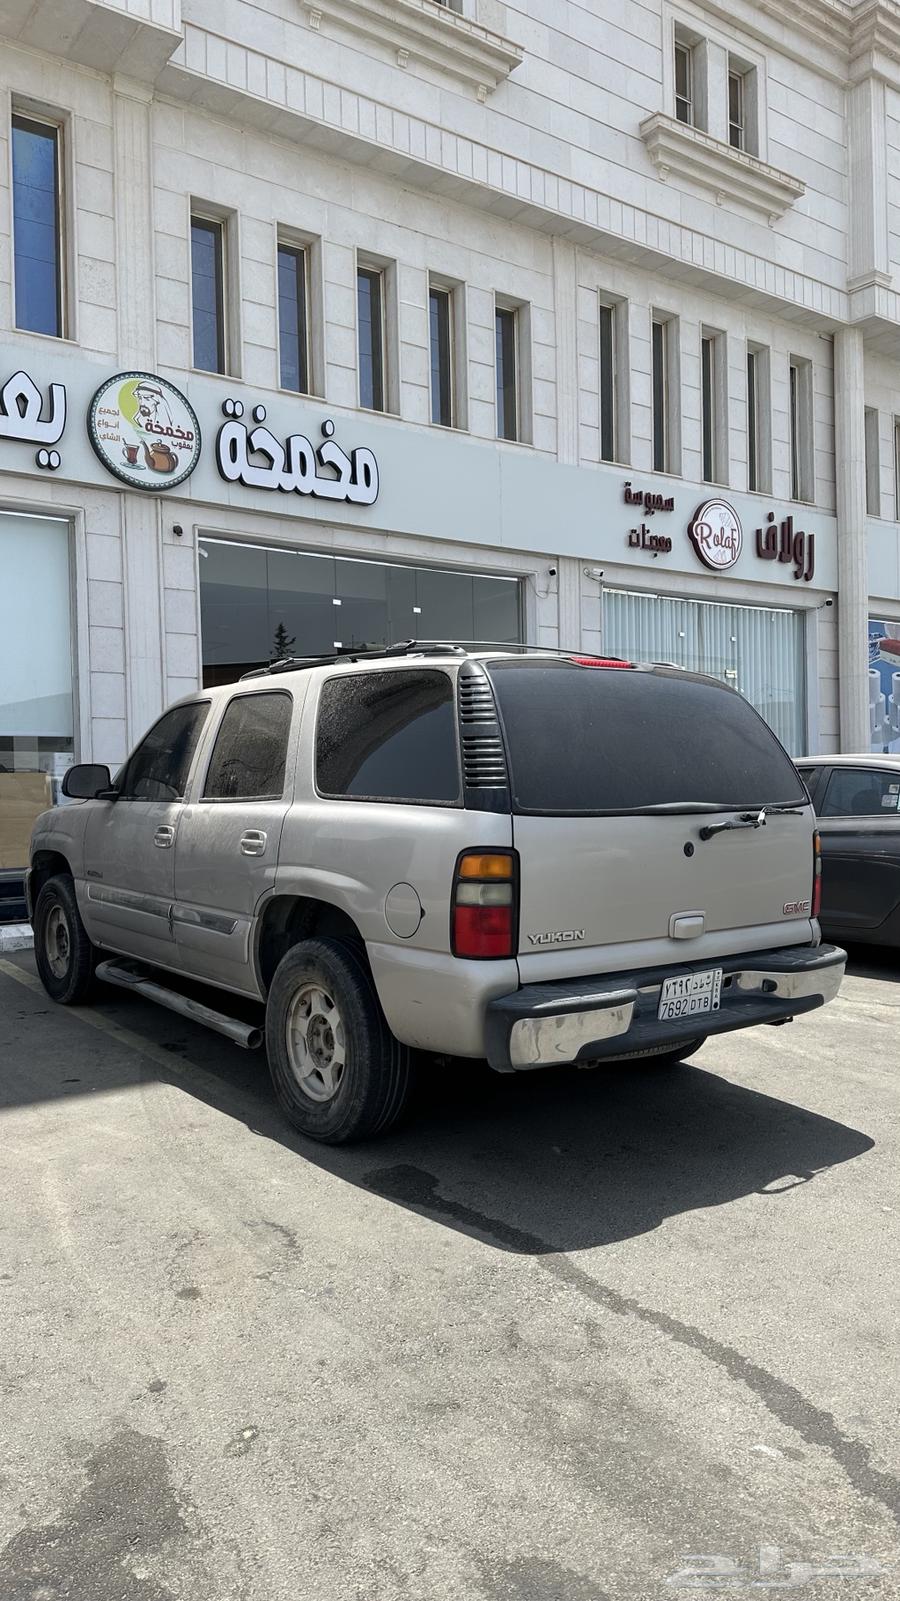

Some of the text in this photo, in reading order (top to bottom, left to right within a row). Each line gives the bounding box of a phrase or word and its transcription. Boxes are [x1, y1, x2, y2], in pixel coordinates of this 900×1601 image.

[0, 370, 67, 471] يع
[98, 406, 120, 417] لجميع
[99, 432, 121, 443] الشاي
[145, 419, 194, 440] مخمخة
[171, 441, 194, 452] يعقوب
[216, 398, 380, 505] مخمخة
[623, 481, 675, 516] سمبوسة
[628, 523, 672, 558] معجنات
[755, 511, 815, 582] رولاف
[783, 900, 810, 915] GMC
[527, 929, 585, 946] YUKON
[665, 978, 690, 998] ٧٦٩٢
[661, 999, 688, 1019] 7692
